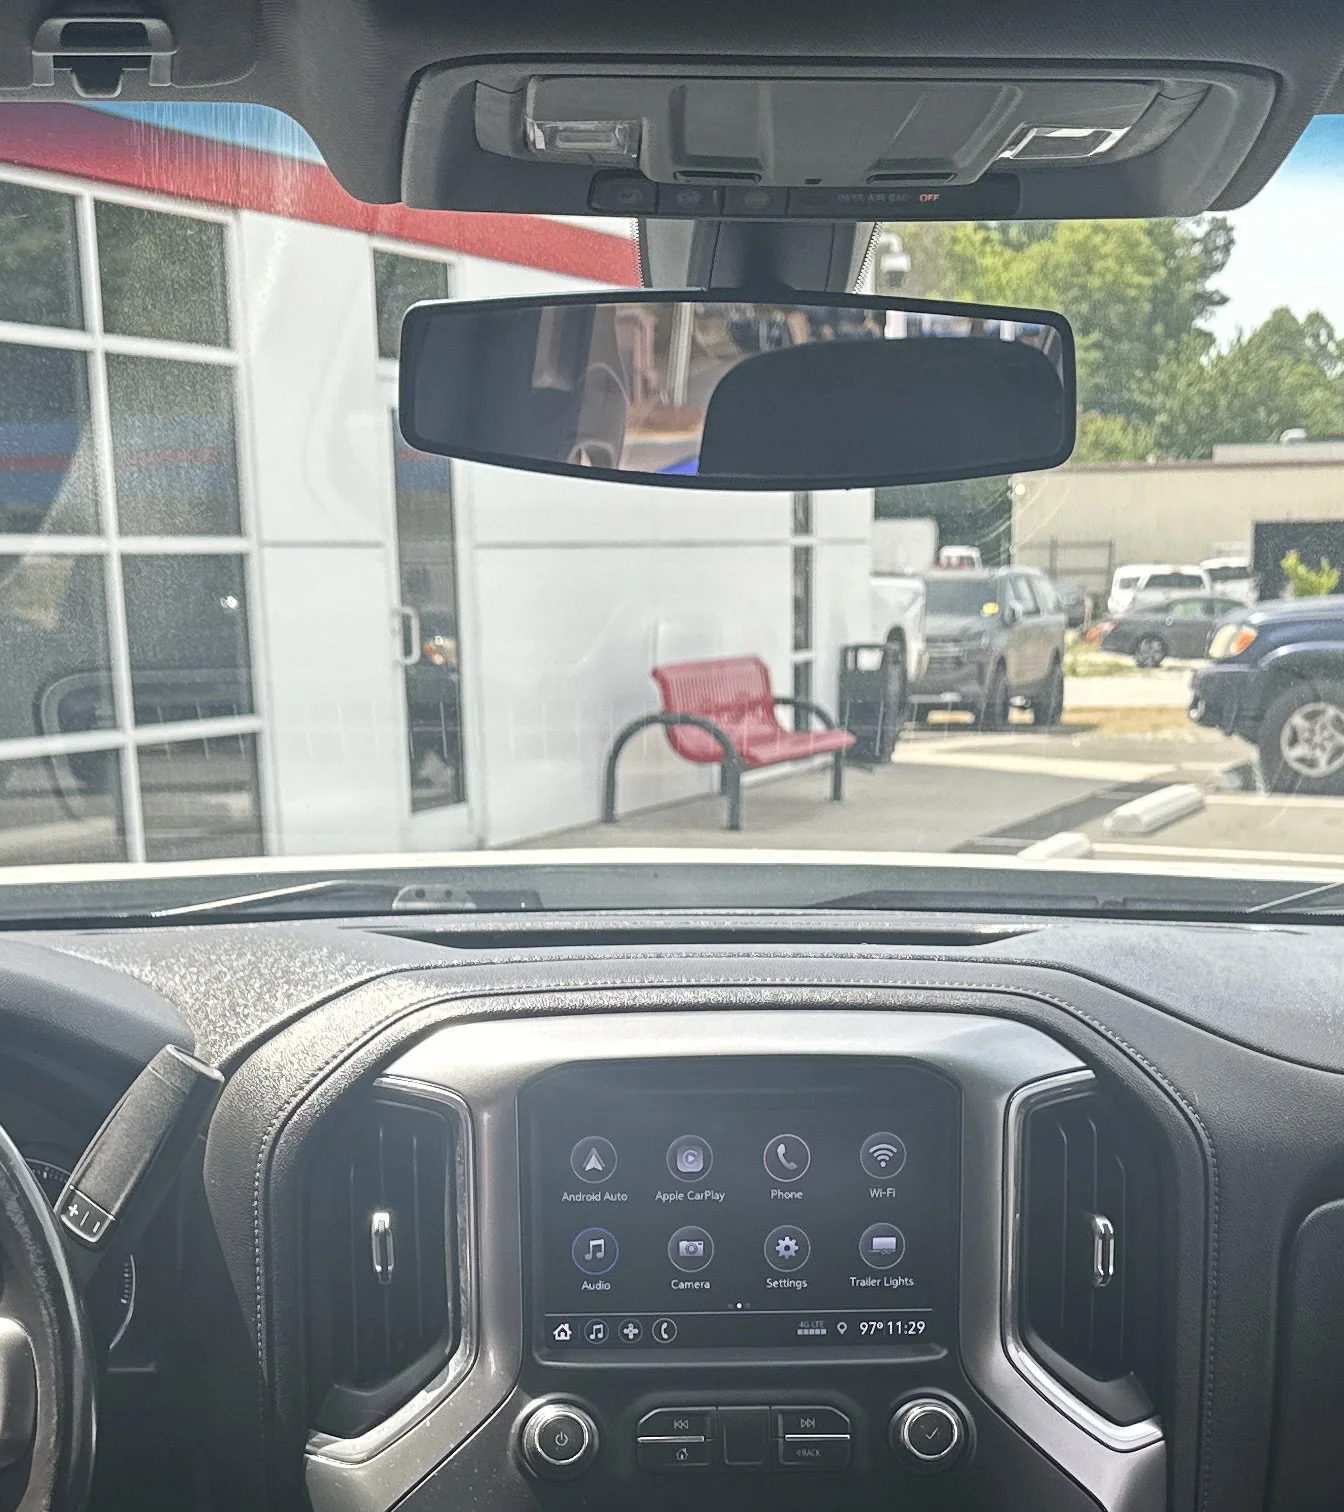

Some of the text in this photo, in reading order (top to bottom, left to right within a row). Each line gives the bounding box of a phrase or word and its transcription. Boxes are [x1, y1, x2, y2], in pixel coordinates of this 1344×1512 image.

[919, 193, 940, 203] OFF
[561, 1191, 628, 1202] Android Auto
[655, 1190, 726, 1203] Apple CarPlay
[770, 1189, 804, 1200] Phone
[869, 1187, 896, 1198] Wi-Fi
[581, 1280, 611, 1291] Audio
[671, 1279, 711, 1290] Camera
[766, 1278, 808, 1290] Settings
[850, 1276, 915, 1289] Trailer Lights
[887, 1319, 926, 1336] 11:29
[801, 1447, 821, 1458] BACK
